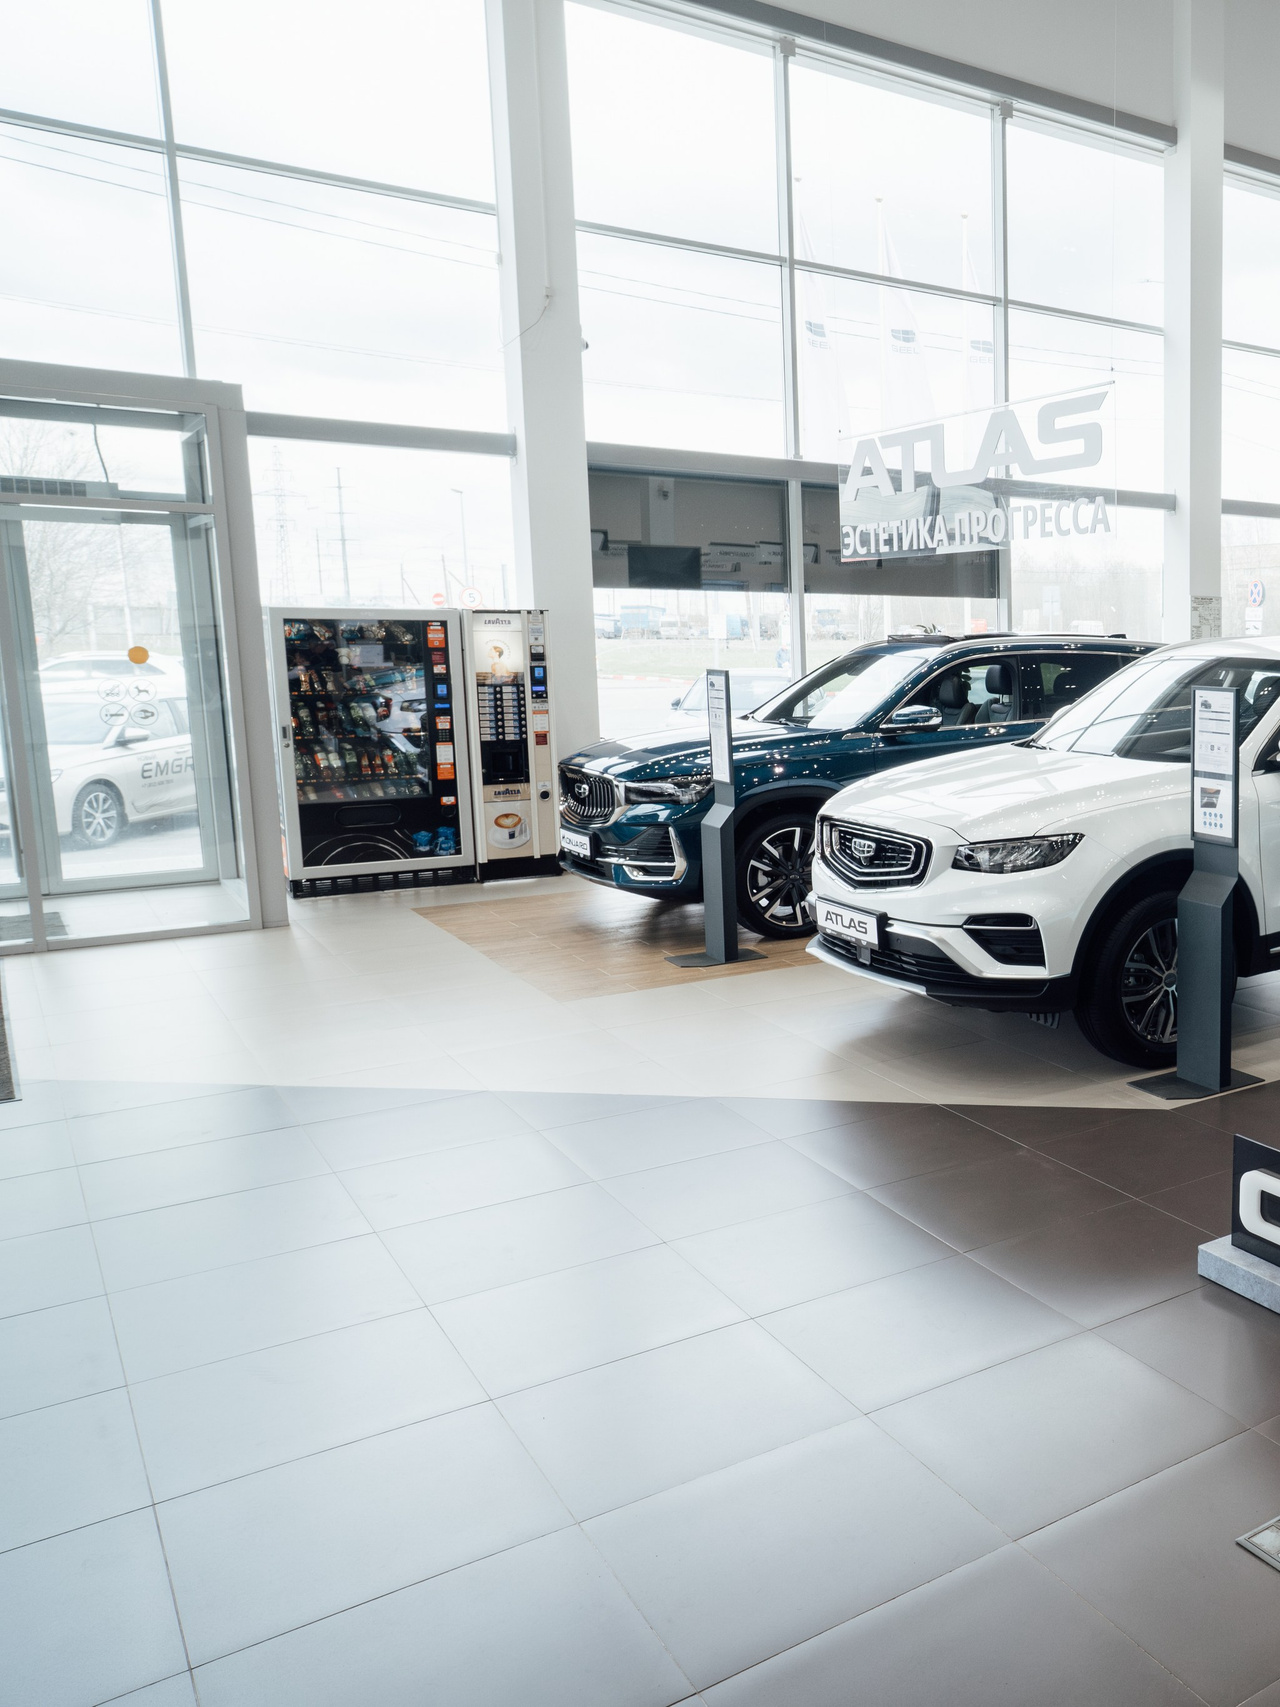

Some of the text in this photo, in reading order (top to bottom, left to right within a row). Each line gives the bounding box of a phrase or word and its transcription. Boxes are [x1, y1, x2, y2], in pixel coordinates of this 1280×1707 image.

[842, 391, 1109, 502] ATLAS
[841, 496, 1111, 556] ЭСТЕТИКА ПРОГРЕССА
[469, 592, 476, 603] 5
[494, 788, 522, 796] LAVAZZA
[825, 910, 868, 935] ATLAS
